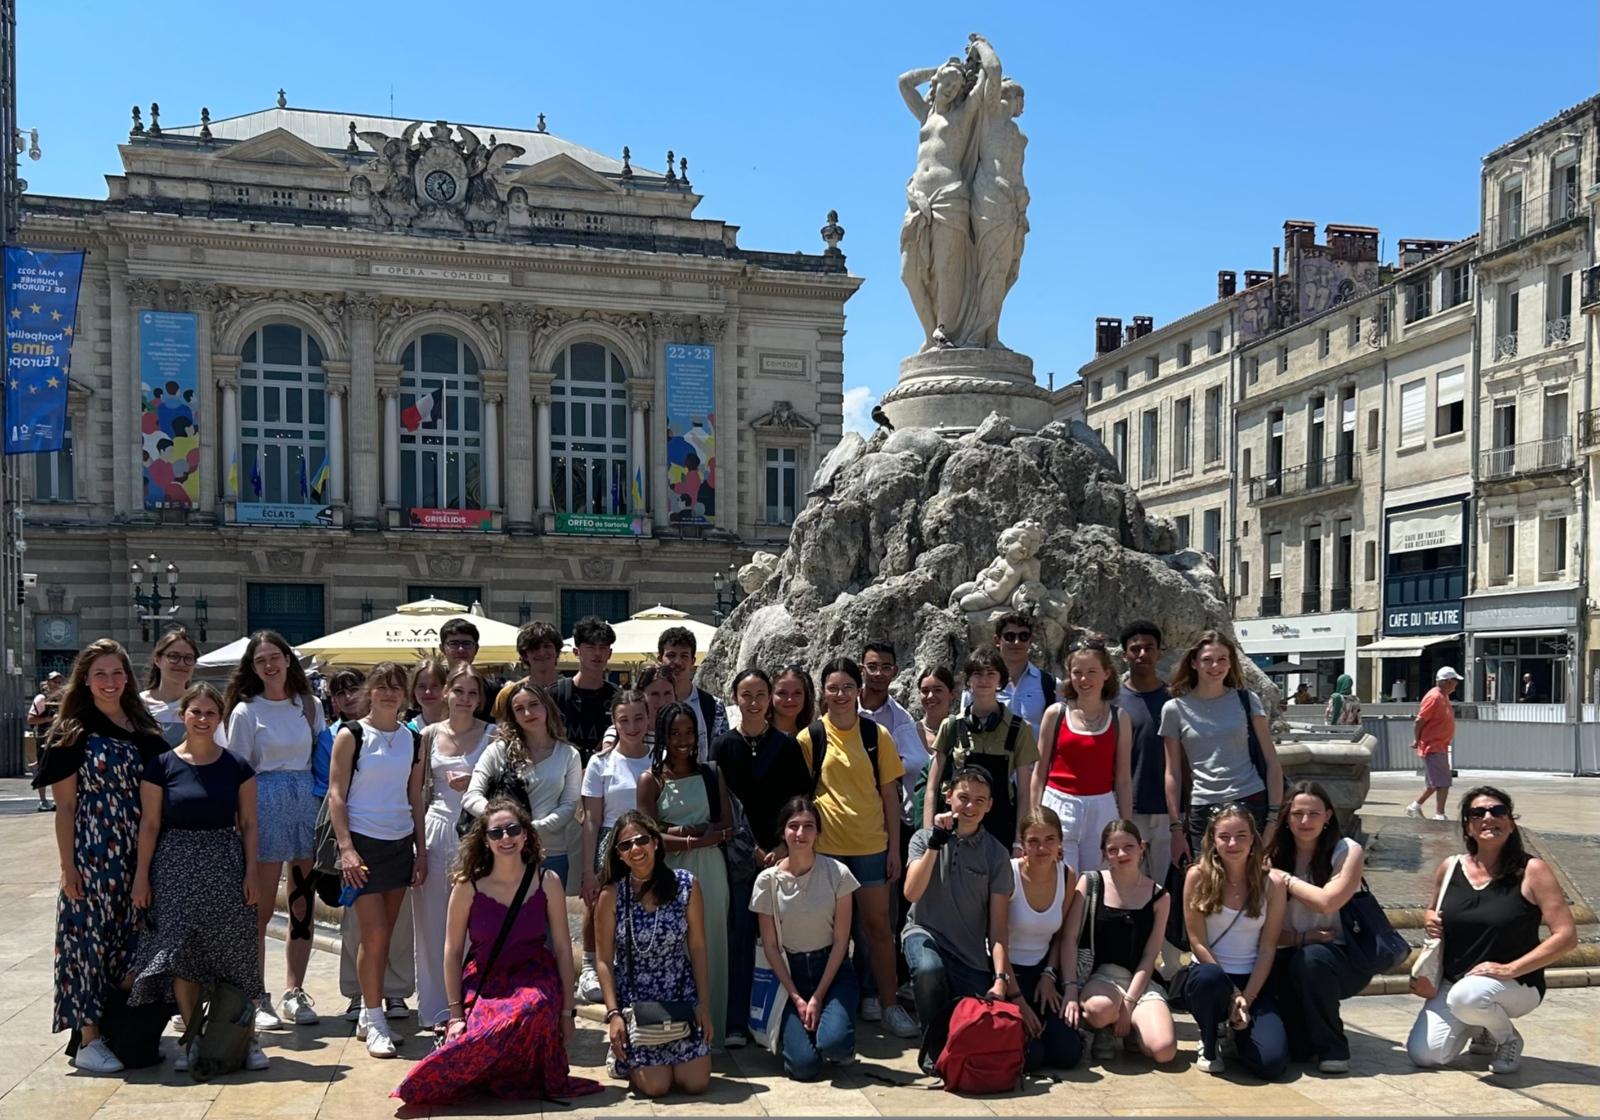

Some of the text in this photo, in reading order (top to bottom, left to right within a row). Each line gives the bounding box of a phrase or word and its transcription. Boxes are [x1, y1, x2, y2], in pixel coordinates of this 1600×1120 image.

[388, 267, 425, 276] OPERA
[443, 272, 494, 281] COMEDIE
[568, 519, 594, 527] ORFEO
[1389, 609, 1459, 628] CAFE DU THEATRE
